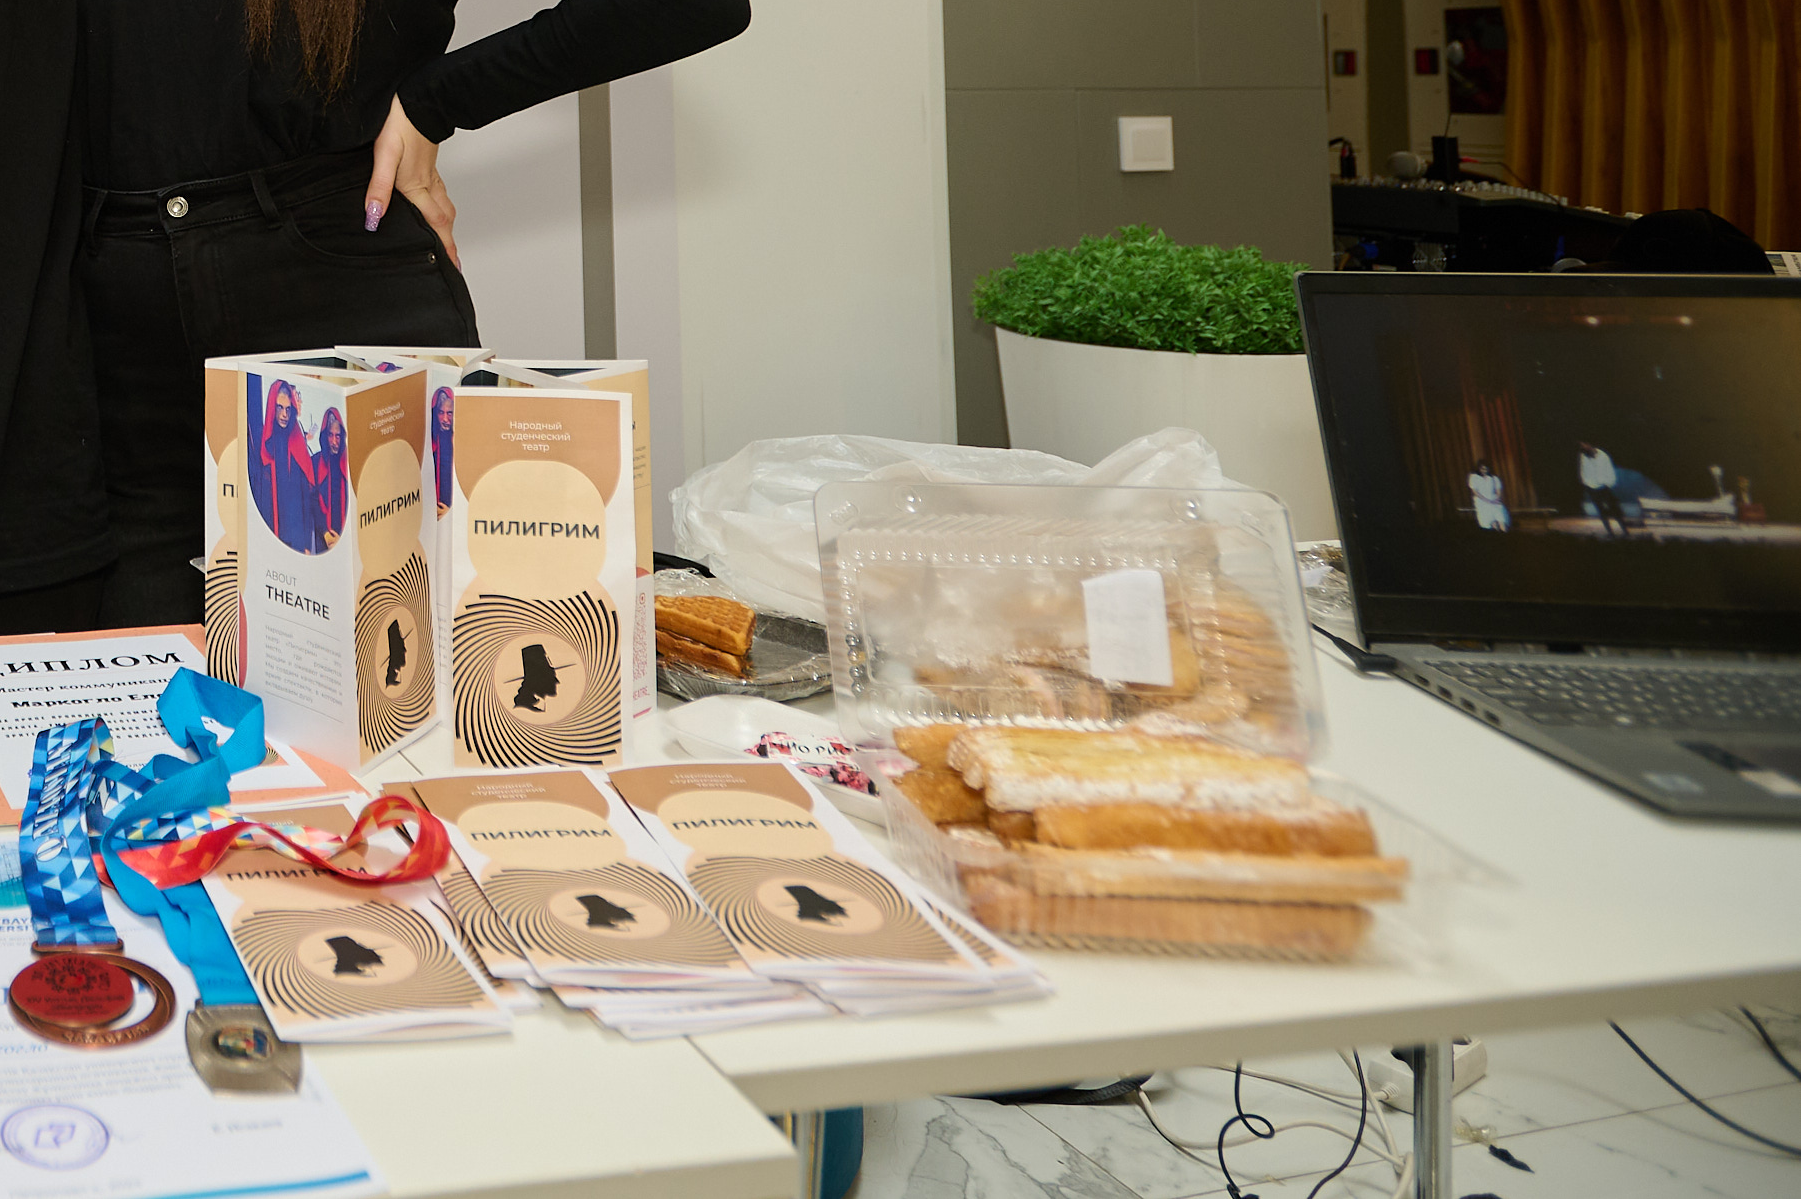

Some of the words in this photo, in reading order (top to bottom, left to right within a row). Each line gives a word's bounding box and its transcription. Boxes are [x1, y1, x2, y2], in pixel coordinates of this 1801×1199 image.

[374, 402, 402, 418] Народный
[380, 425, 395, 436] театр
[509, 421, 563, 432] Народный
[501, 432, 571, 442] студенческий
[522, 443, 550, 452] театр
[359, 489, 421, 529] ПИЛИГРИМ
[474, 519, 600, 540] ПИЛИГРИМ
[265, 569, 298, 587] ABOUT
[265, 584, 331, 620] THEATRE
[58, 678, 171, 691] коммуникац
[10, 696, 124, 709] Маркогло
[672, 818, 818, 831] ПИЛИГРИМ
[470, 829, 613, 842] ПИЛИГРИМ
